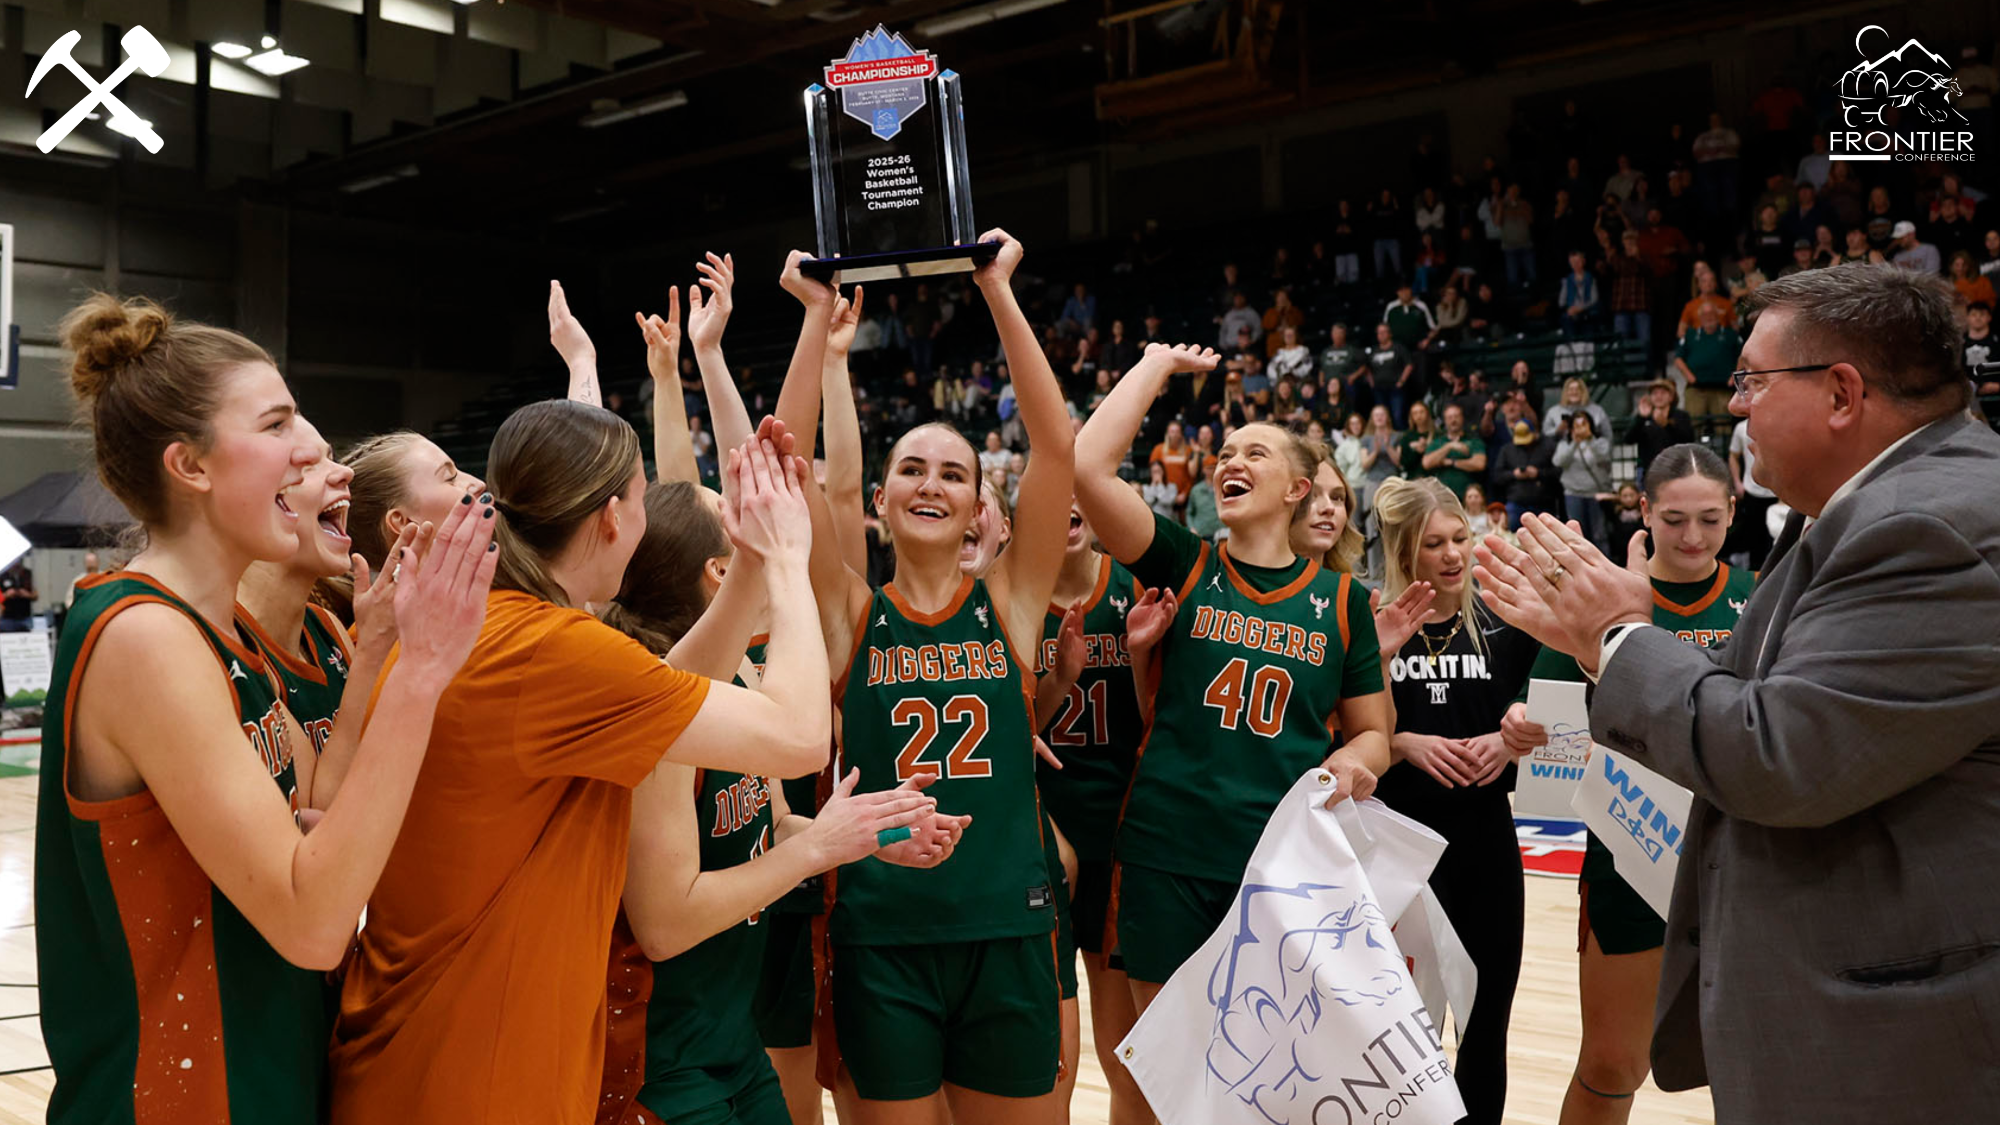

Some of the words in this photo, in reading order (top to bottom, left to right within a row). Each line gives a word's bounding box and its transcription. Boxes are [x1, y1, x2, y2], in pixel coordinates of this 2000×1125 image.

[833, 64, 929, 84] CHAMPIONSHIP
[845, 62, 874, 70] WOMEN'S
[876, 58, 916, 68] BASKETBALL
[866, 166, 914, 178] Women's
[868, 155, 911, 168] 2025-26
[861, 186, 924, 200] Tournament
[865, 175, 918, 189] Basketball
[868, 198, 920, 210] Champion
[1190, 605, 1327, 666] DIGGERS
[867, 639, 1008, 687] DIGGERS
[1389, 655, 1438, 682] OCK
[1439, 654, 1459, 679] IT
[1461, 654, 1492, 680] IN.
[1203, 657, 1294, 739] 40
[1050, 679, 1109, 746] 21
[891, 694, 993, 783] 22
[1604, 753, 1684, 856] WIN
